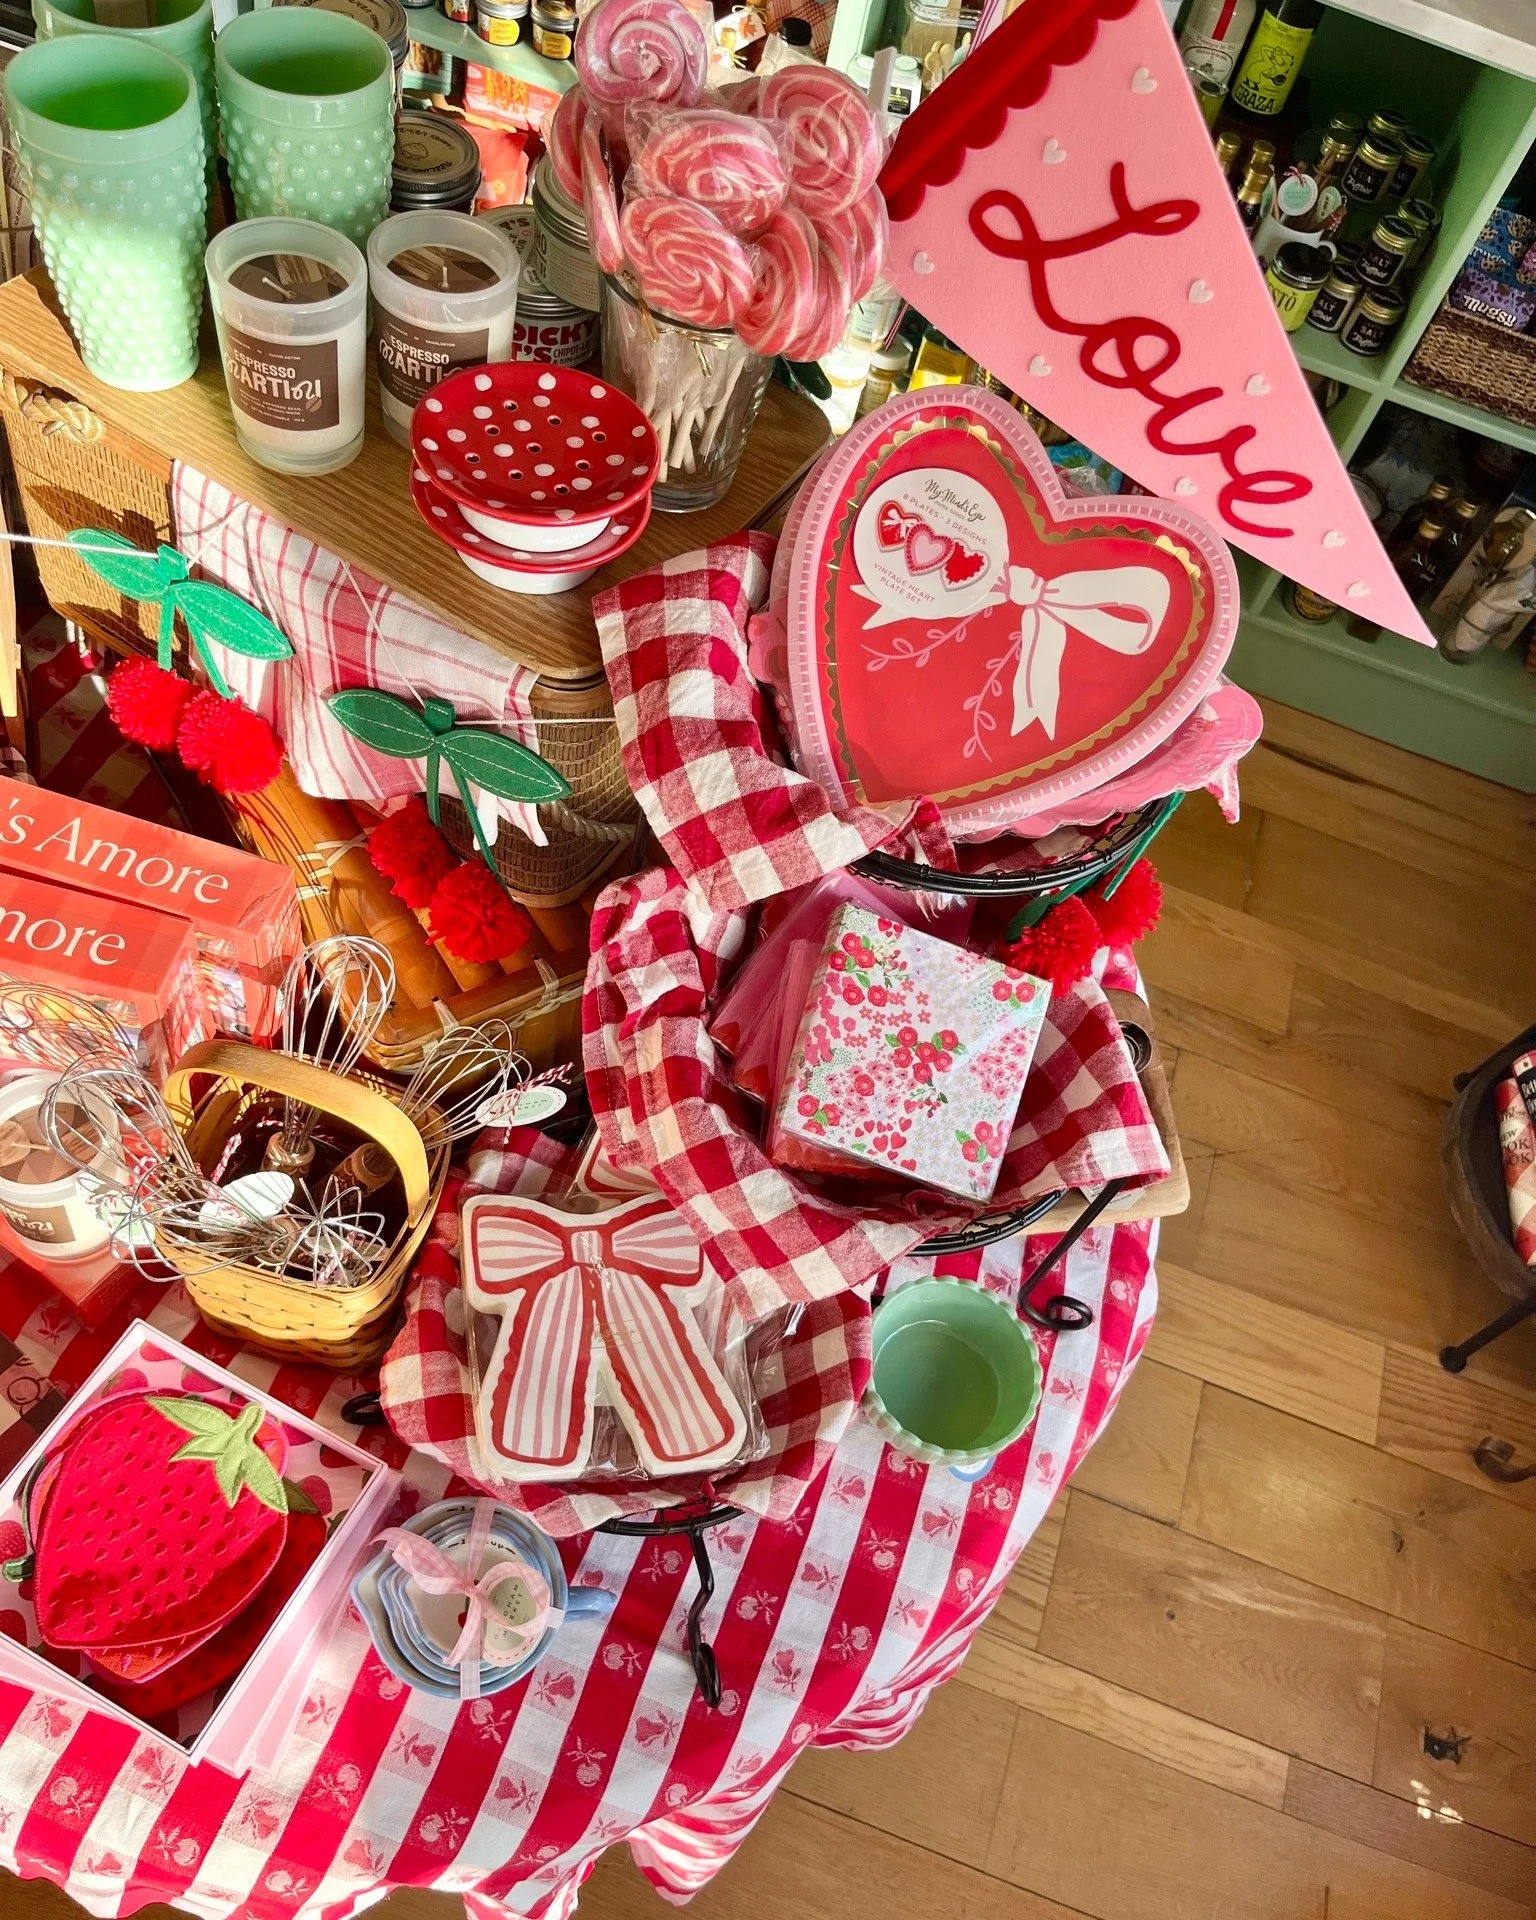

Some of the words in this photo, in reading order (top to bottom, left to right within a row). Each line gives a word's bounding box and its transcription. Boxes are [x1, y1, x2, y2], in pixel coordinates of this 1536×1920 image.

[1236, 84, 1275, 113] GRAZA
[1463, 294, 1517, 328] Mugsy
[233, 348, 296, 379] ESPRESSO
[379, 338, 464, 383] MARTI
[390, 335, 450, 365] ESPRESSO
[968, 160, 1314, 539] Love
[225, 351, 322, 400] MARTINI
[909, 496, 940, 518] PLATES
[951, 522, 988, 546] DESIGNS
[924, 478, 942, 500] My
[941, 488, 970, 513] Mind's
[967, 503, 987, 523] Eye
[874, 562, 908, 587] VINTAGE
[908, 584, 936, 603] HEART
[880, 576, 906, 596] PLATE
[905, 592, 922, 605] SET
[33, 815, 230, 905] Amore
